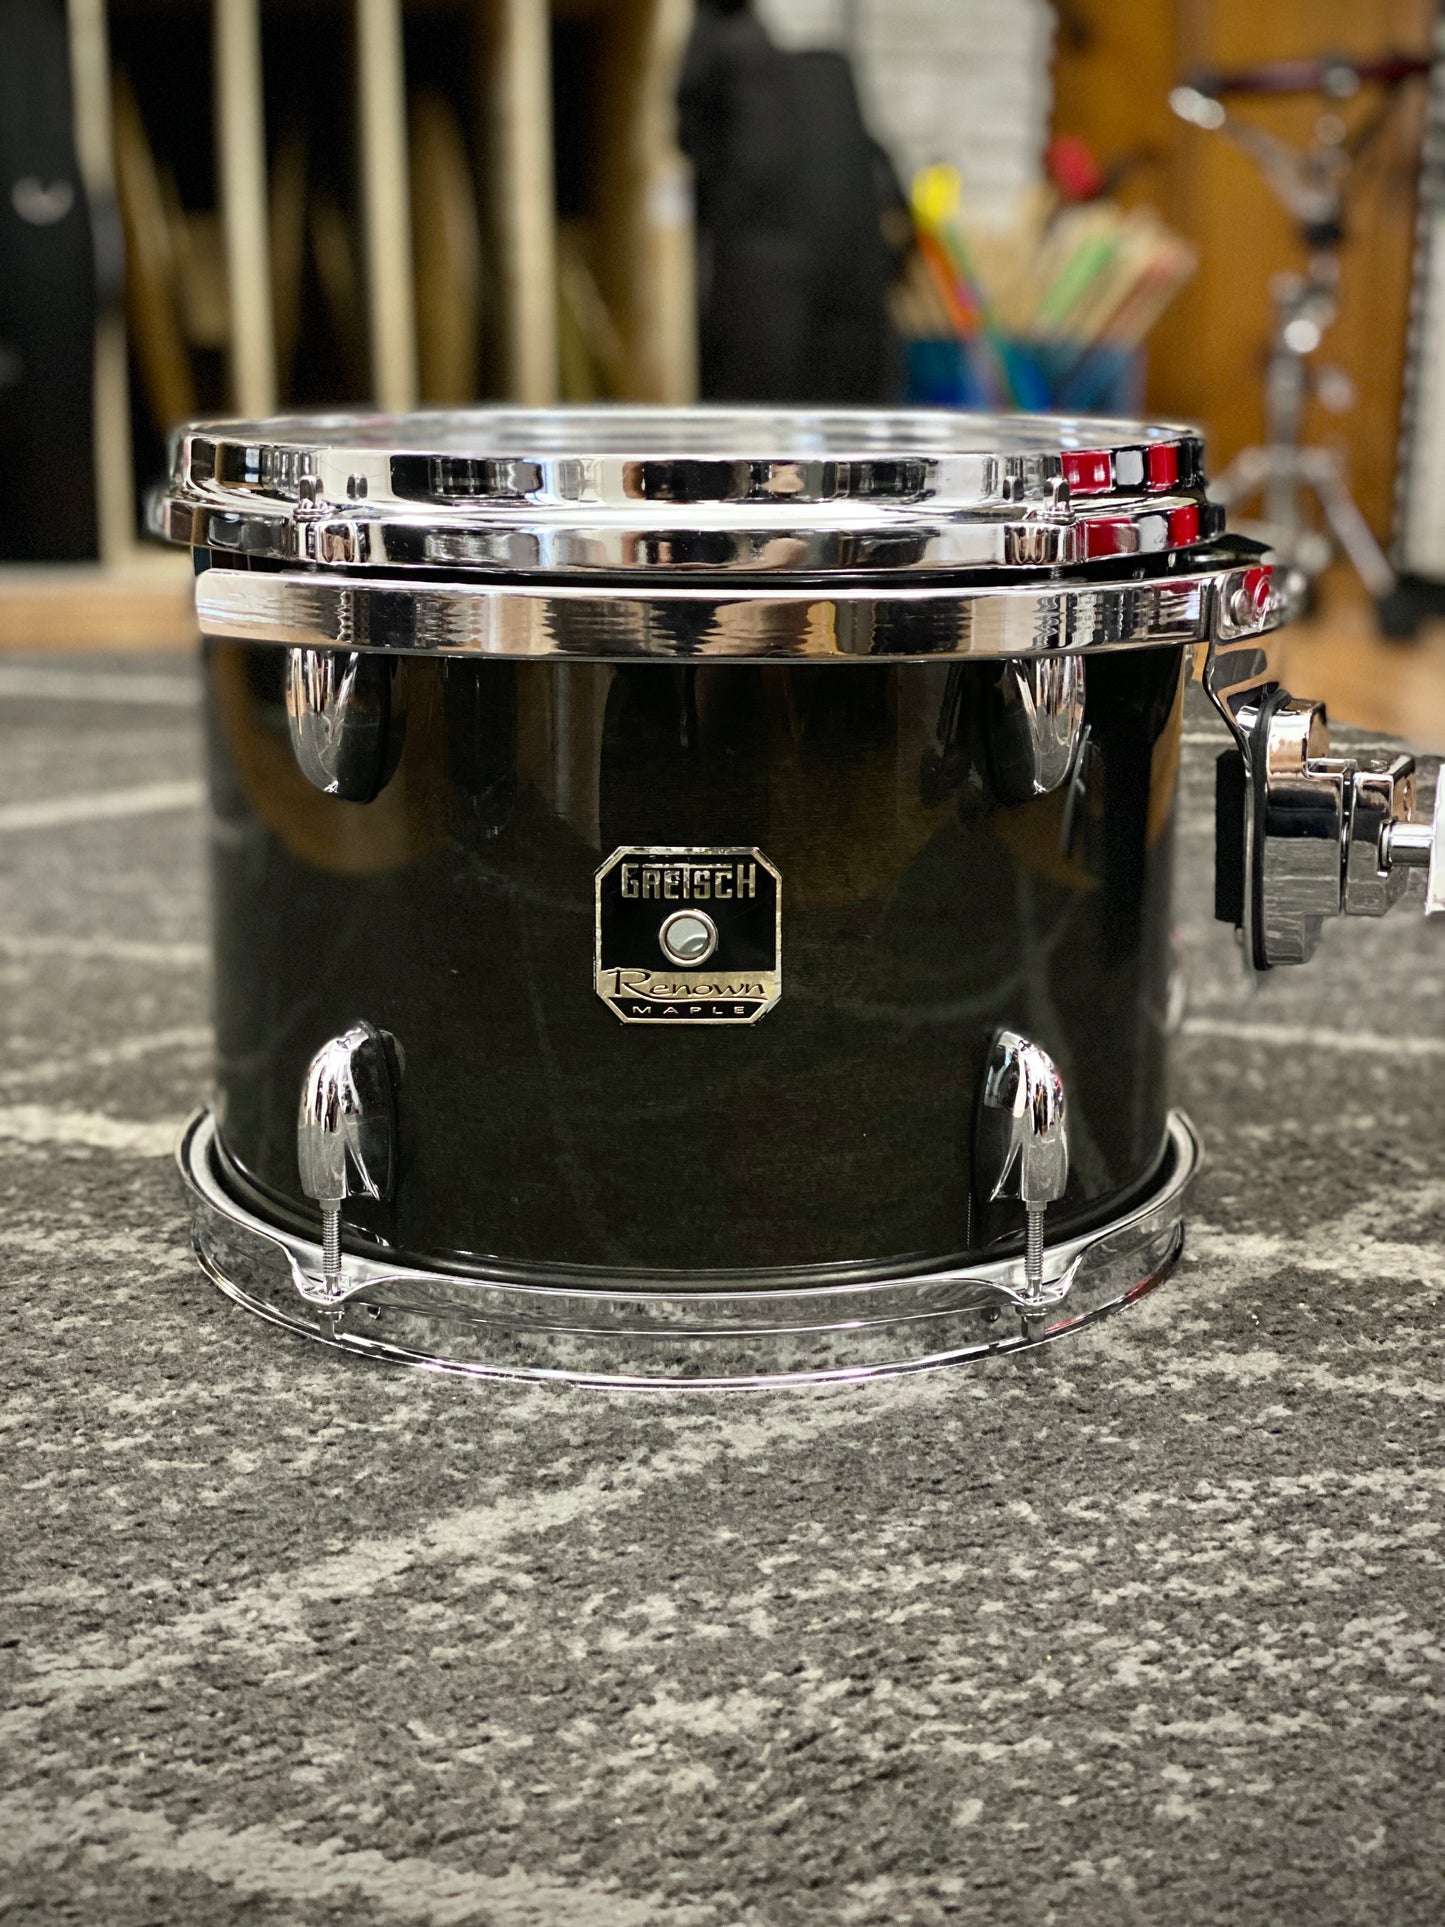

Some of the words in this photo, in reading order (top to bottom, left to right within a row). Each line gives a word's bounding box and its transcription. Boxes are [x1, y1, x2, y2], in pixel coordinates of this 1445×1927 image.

[621, 863, 756, 899] GRETSCH
[607, 968, 768, 1001] Renown
[632, 1006, 745, 1015] MAPLE
